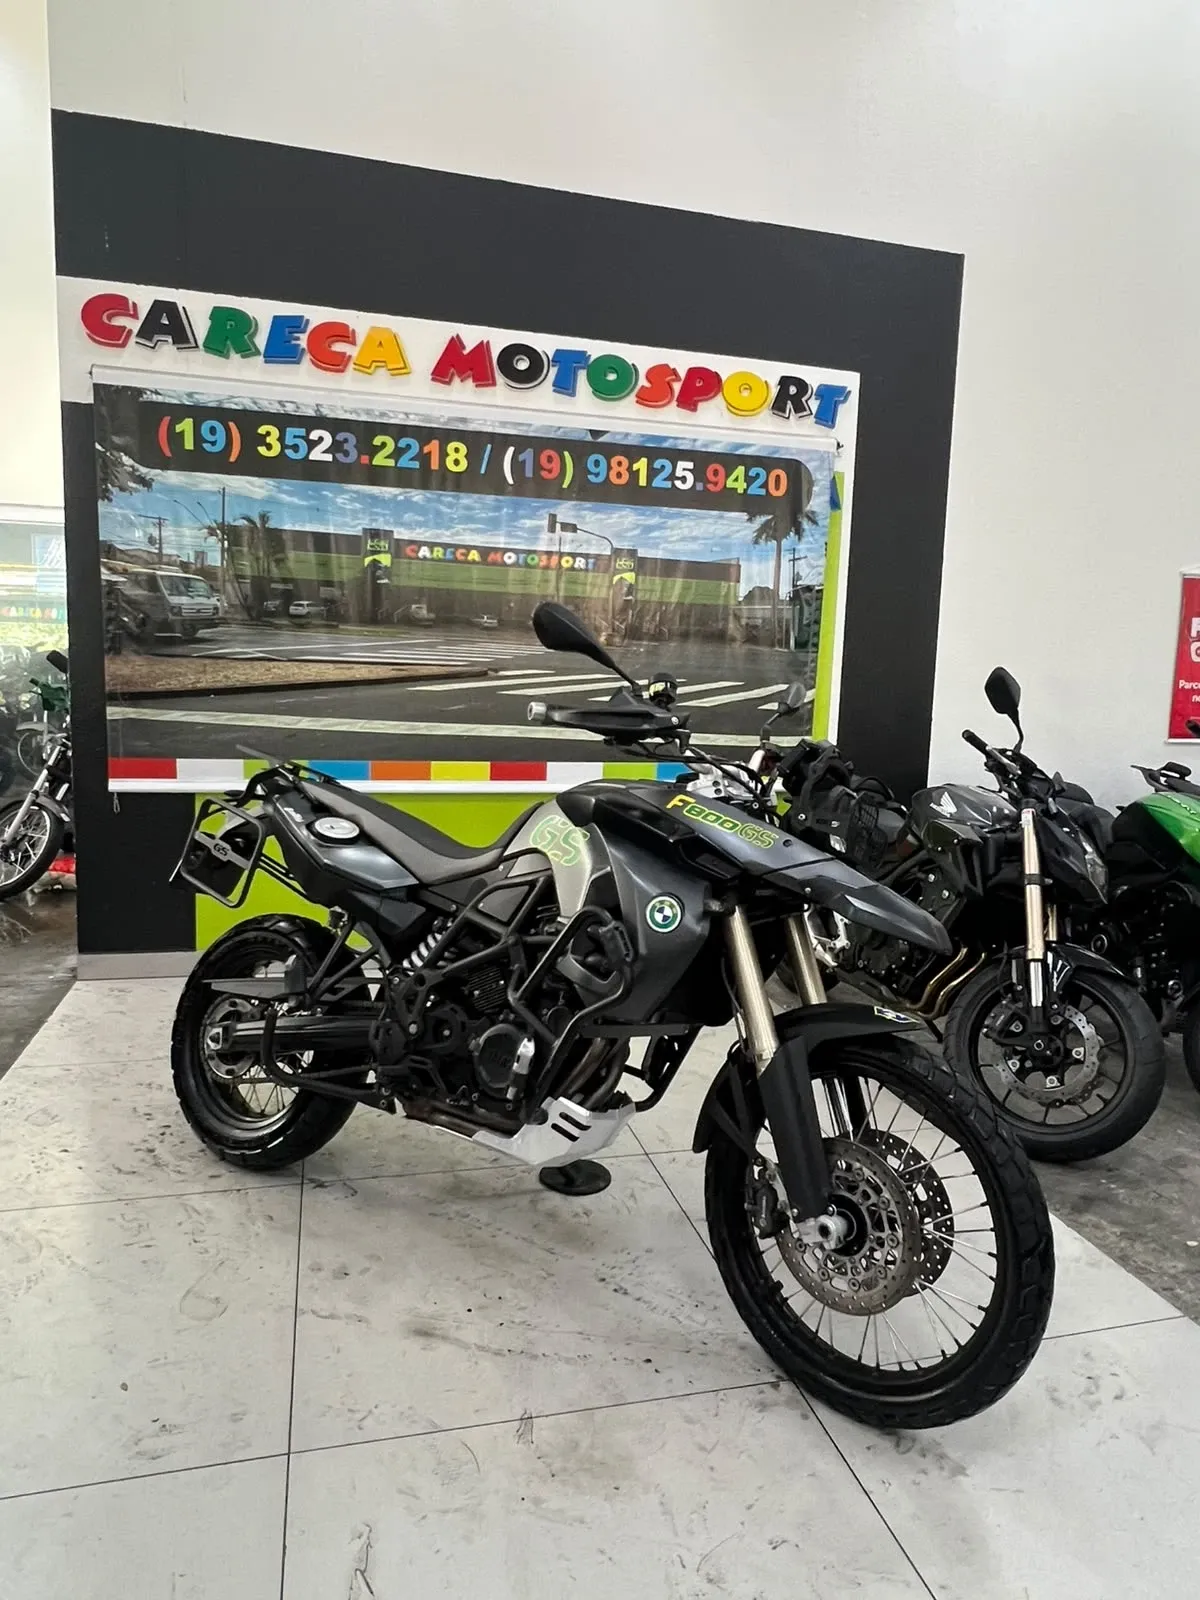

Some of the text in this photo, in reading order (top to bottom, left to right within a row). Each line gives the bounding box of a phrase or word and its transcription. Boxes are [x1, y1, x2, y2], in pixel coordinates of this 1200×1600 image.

[81, 293, 851, 429] CARECA MOTOSPORT
[157, 415, 241, 462] (19)
[256, 424, 468, 474] 3523.2218
[503, 445, 574, 489] (19)
[586, 453, 788, 497] 98125.9420
[405, 544, 481, 562] CARECA
[1179, 680, 1200, 689] Parc
[213, 843, 229, 856] GS
[529, 815, 590, 866] GS
